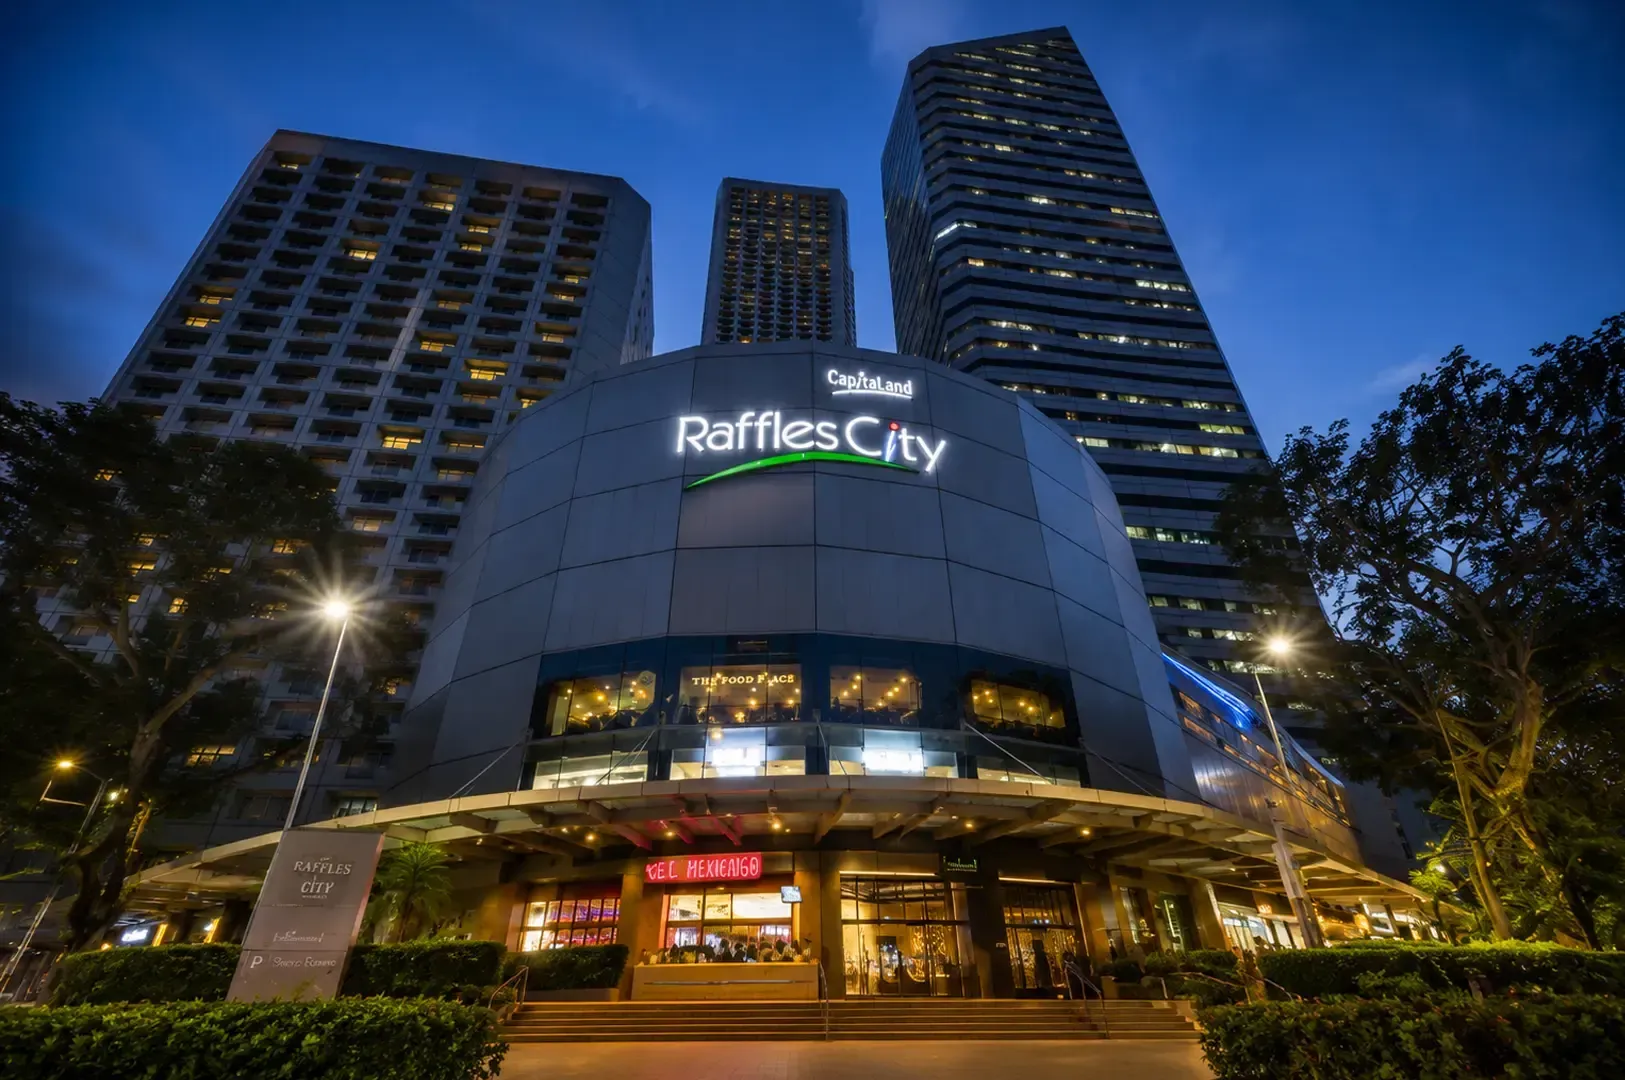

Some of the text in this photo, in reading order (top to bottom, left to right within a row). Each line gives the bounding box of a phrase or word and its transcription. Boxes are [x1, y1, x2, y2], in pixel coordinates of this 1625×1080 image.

[827, 369, 913, 394] CapitaLand
[676, 410, 947, 473] Raffles City
[692, 674, 795, 686] THE FOOD PACE
[293, 861, 352, 875] RAFFLES
[301, 875, 334, 894] CITY
[250, 955, 263, 969] P
